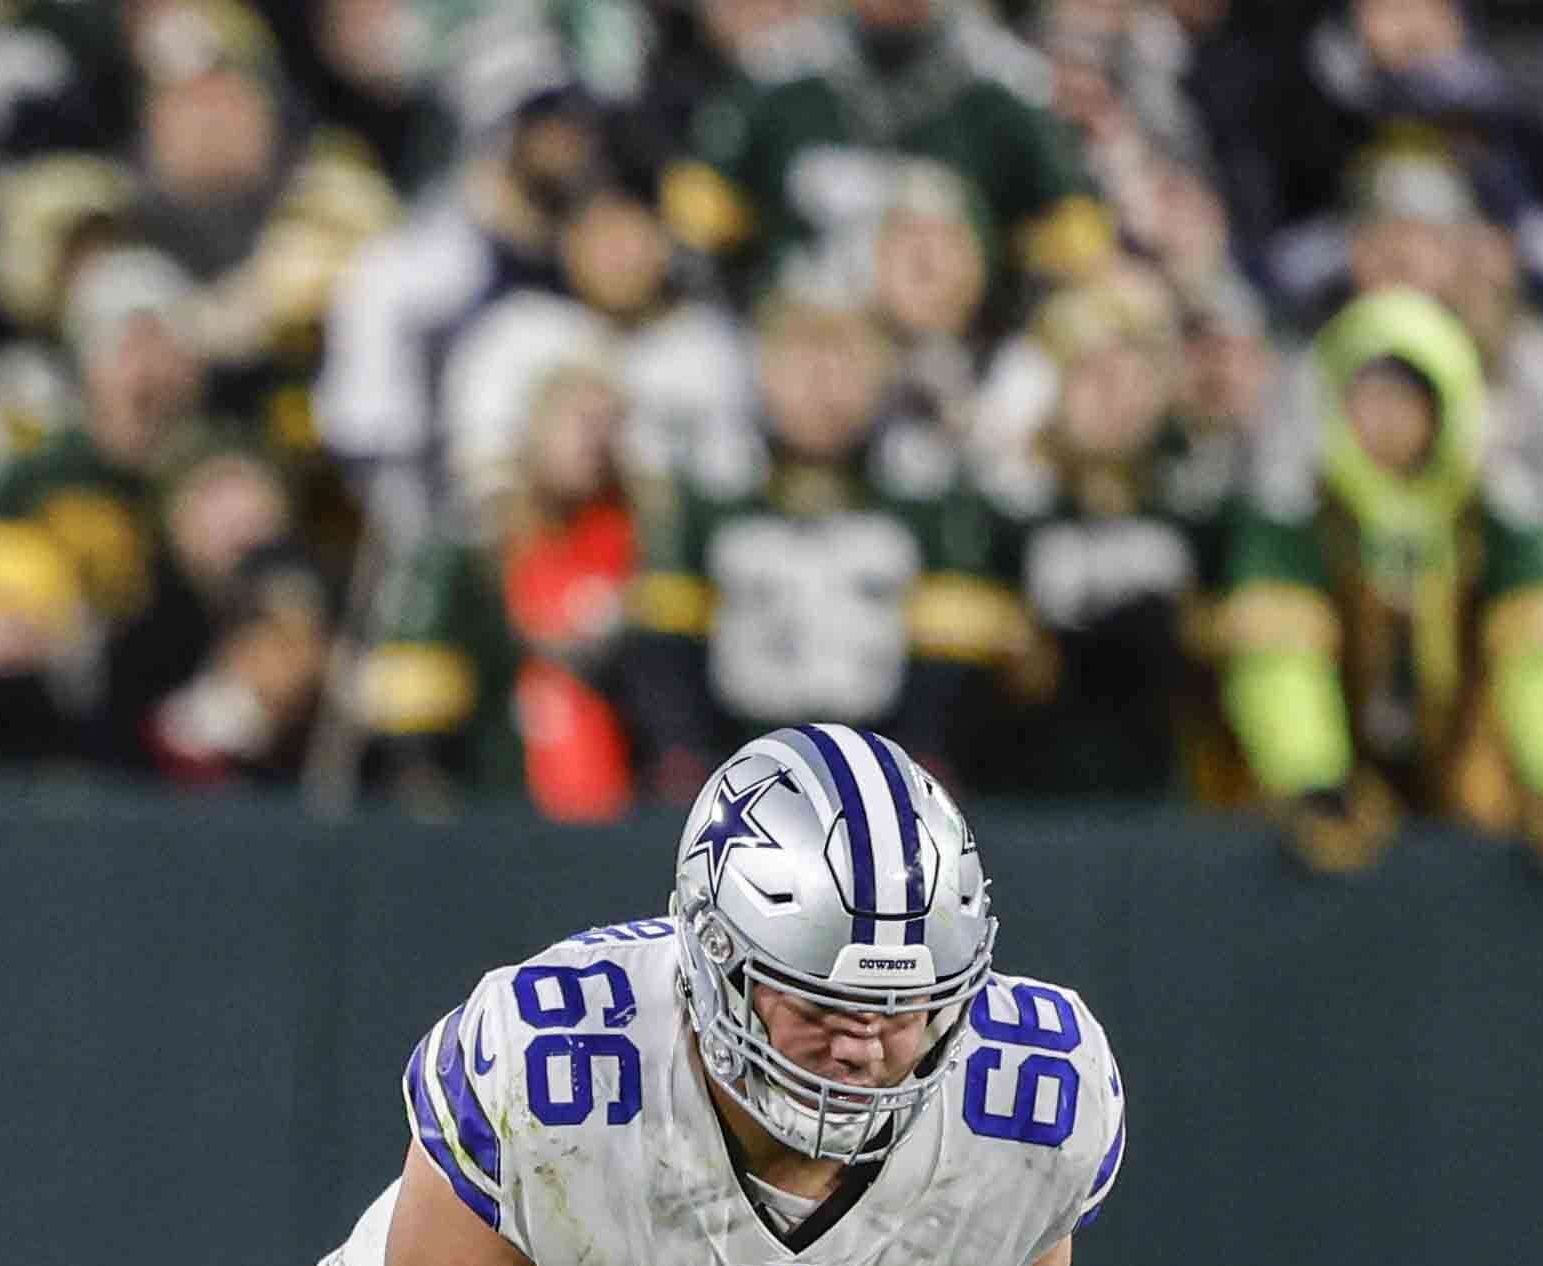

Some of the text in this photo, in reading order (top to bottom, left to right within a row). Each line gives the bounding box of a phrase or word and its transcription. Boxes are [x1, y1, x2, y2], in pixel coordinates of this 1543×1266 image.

[514, 959, 642, 1127] 66
[859, 959, 917, 970] COWBOYS
[963, 981, 1080, 1148] 66
